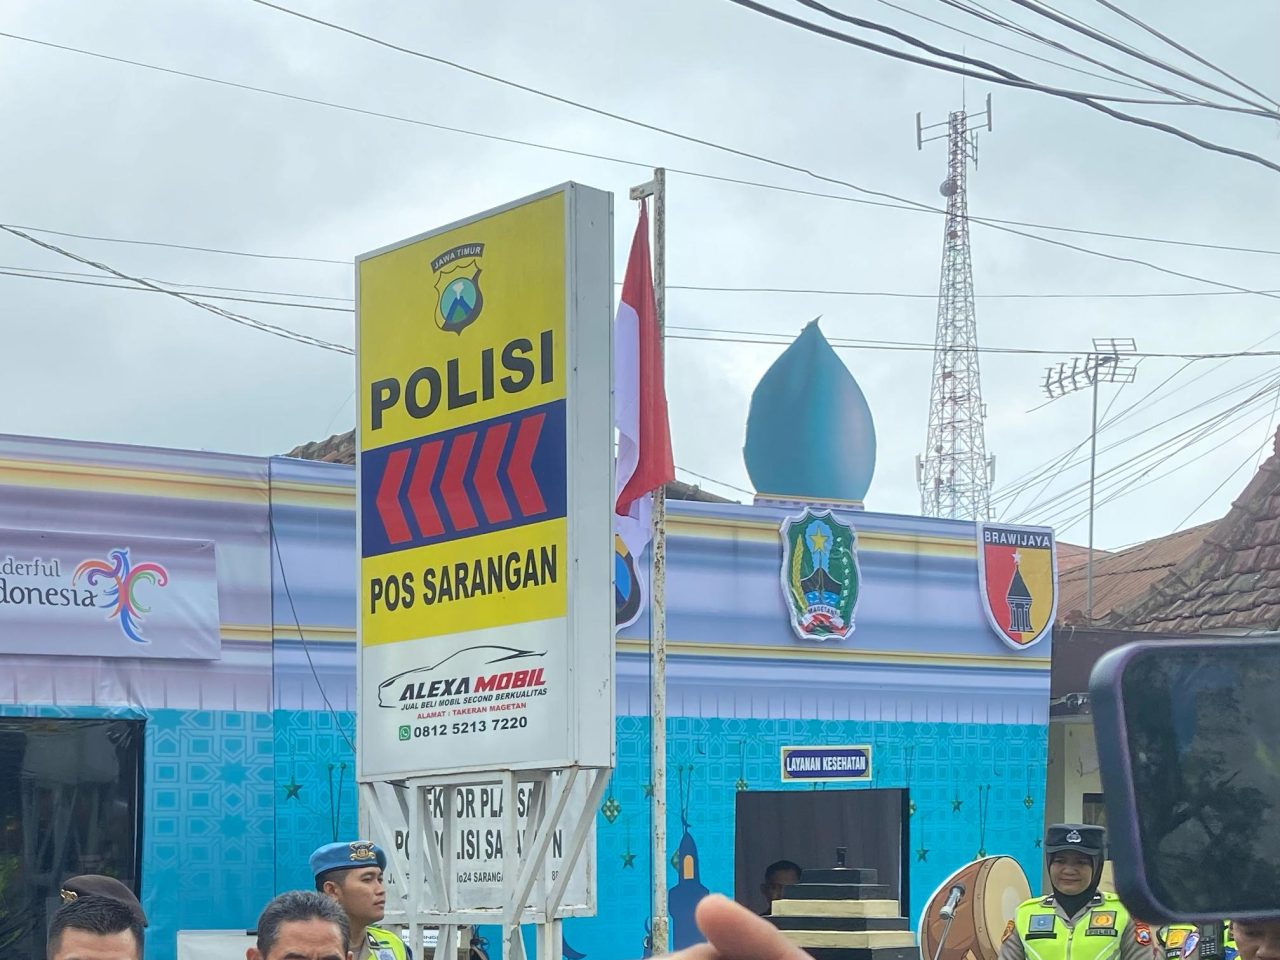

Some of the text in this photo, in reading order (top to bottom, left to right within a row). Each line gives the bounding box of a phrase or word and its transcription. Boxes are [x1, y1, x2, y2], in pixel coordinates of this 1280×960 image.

[435, 246, 481, 269] JAWA TIMUR
[371, 330, 553, 431] POLISI
[984, 531, 1050, 547] BRAWIJAYA
[370, 544, 557, 614] POS SARANGAN
[399, 668, 546, 701] ALEXA MOBIL
[401, 688, 547, 711] JUAL BELI MOBIL SECOND BERKUALITAS
[417, 711, 446, 720] ALAMAT
[453, 707, 487, 716] TAKERAN
[489, 702, 527, 712] MAGETAN
[414, 716, 528, 738] 0812 5213 7220
[786, 756, 866, 771] LAYANAN KESEHATAN
